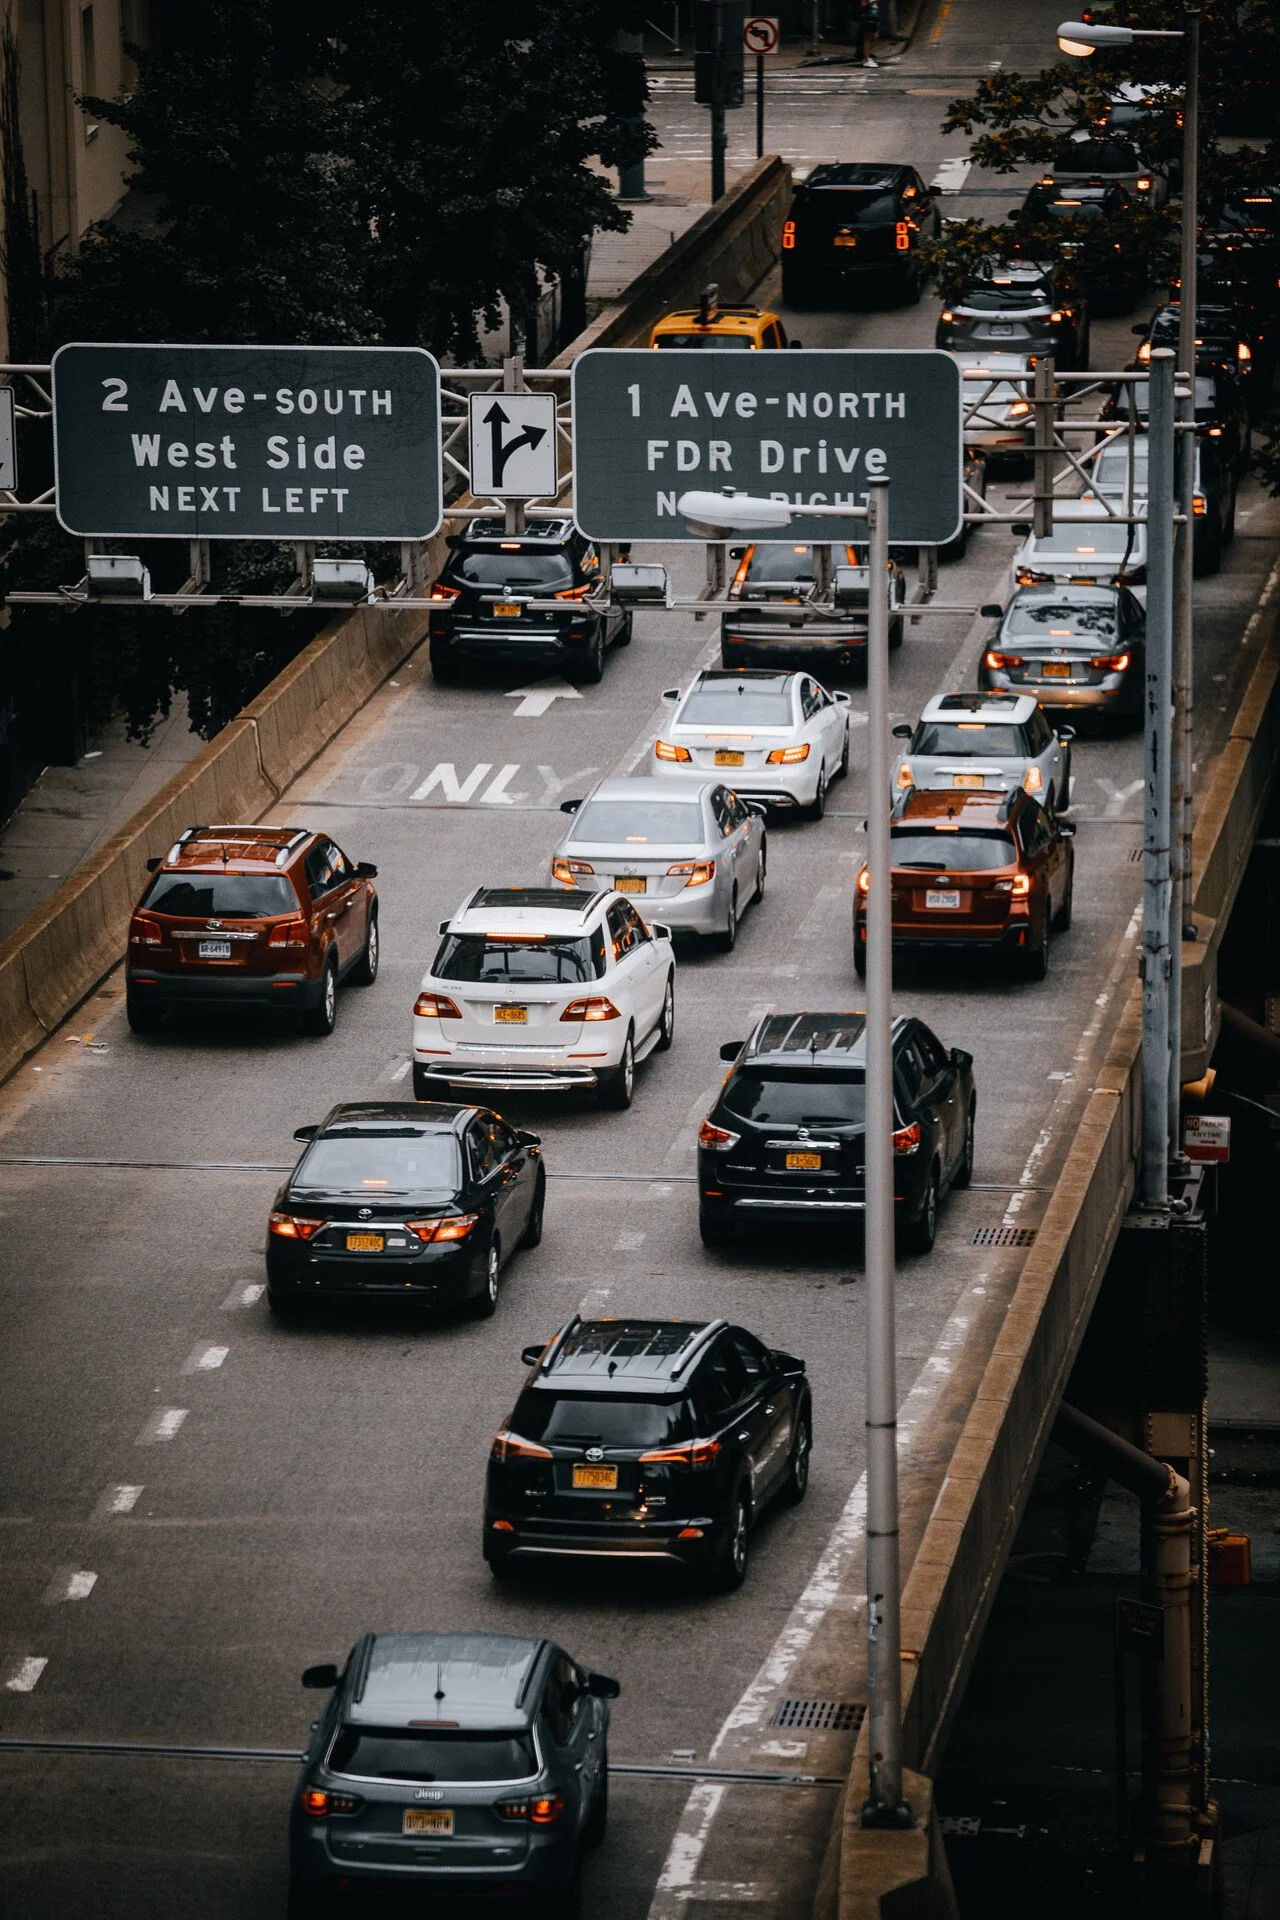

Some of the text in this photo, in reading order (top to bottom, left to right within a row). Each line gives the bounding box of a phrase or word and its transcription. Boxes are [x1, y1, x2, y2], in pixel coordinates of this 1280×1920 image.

[102, 378, 392, 415] 2 Ave-SOUTH
[628, 384, 906, 418] 1 Ave-NORTH
[132, 434, 366, 470] West Side
[647, 440, 888, 473] FDR Drive
[150, 486, 349, 513] NEXT LEFT
[358, 762, 601, 806] ONLY
[1185, 1118, 1198, 1129] NO
[414, 1788, 444, 1801] Jeep
